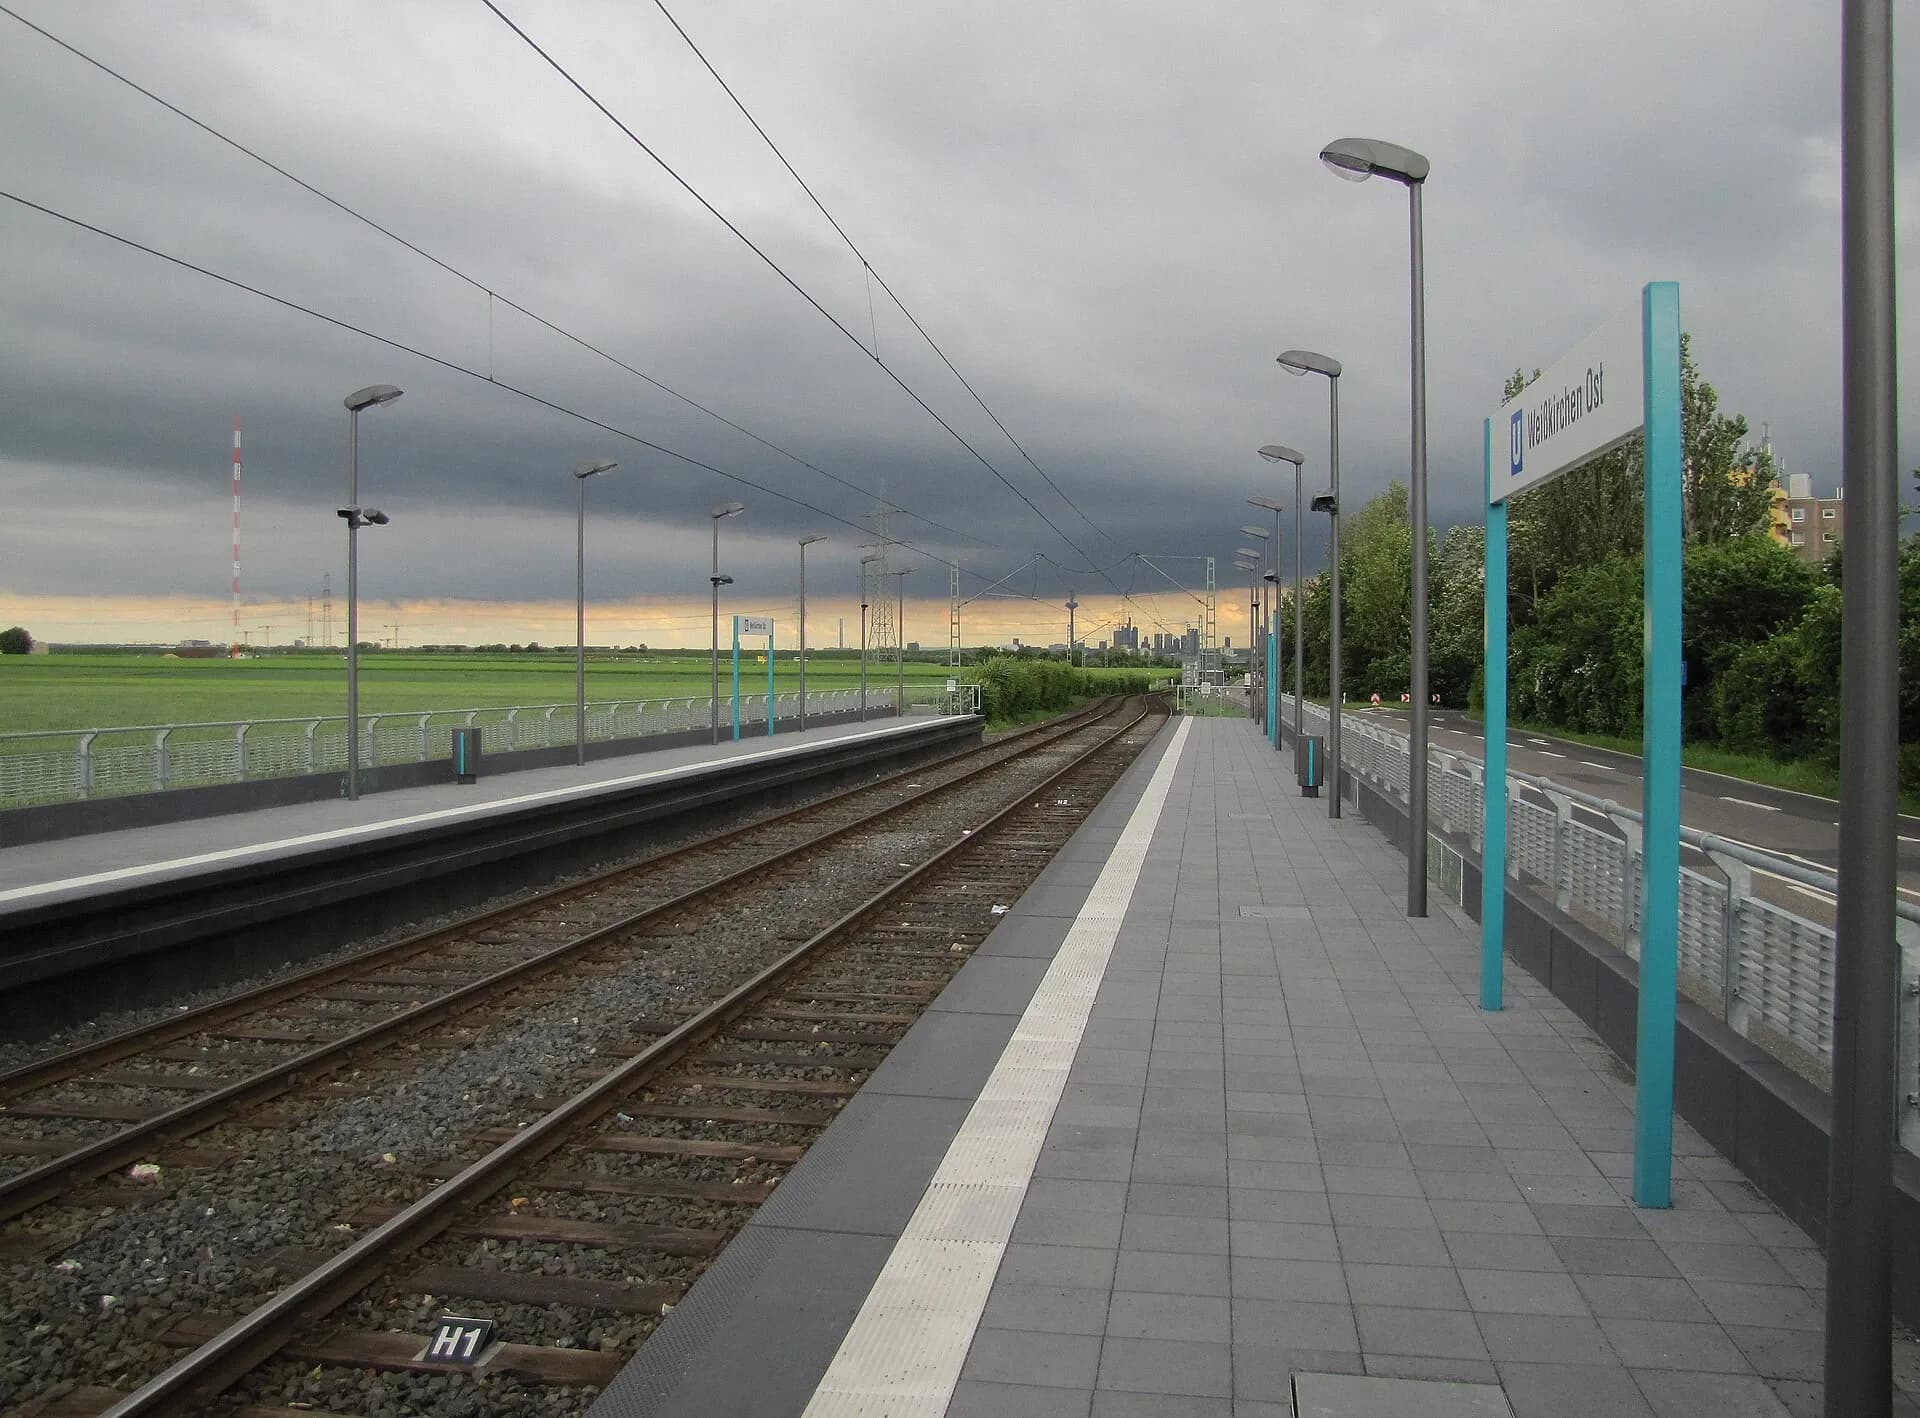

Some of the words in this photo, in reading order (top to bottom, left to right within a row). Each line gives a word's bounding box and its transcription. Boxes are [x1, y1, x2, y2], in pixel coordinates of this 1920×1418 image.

[1512, 419, 1521, 466] U
[1527, 386, 1582, 449] Weißkirchen
[1585, 361, 1604, 413] Ost
[431, 1325, 482, 1357] H1
